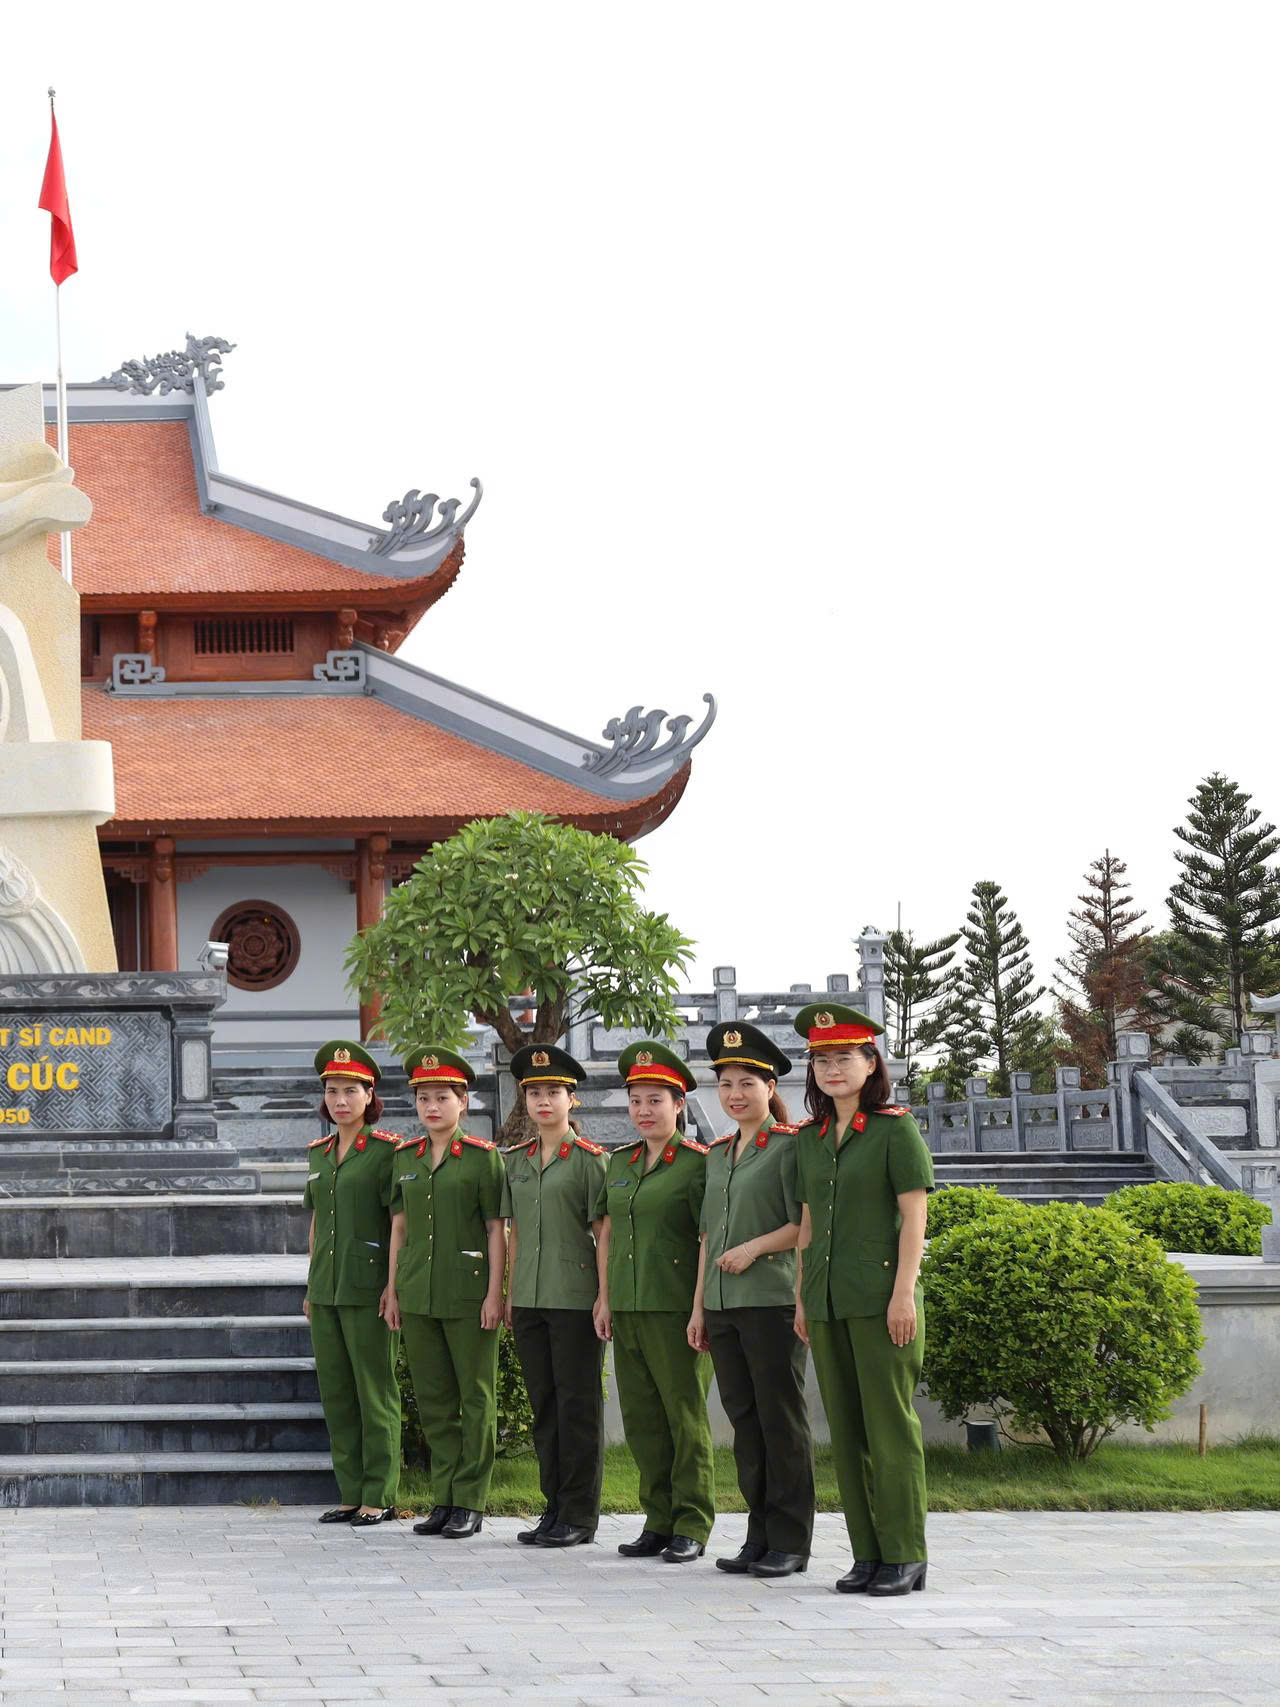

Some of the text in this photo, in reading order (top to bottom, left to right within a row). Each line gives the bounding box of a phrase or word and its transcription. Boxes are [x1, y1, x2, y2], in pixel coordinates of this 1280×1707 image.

[19, 1024, 41, 1047] SĨ
[49, 1027, 112, 1047] CAND
[7, 1056, 79, 1092] CÚC
